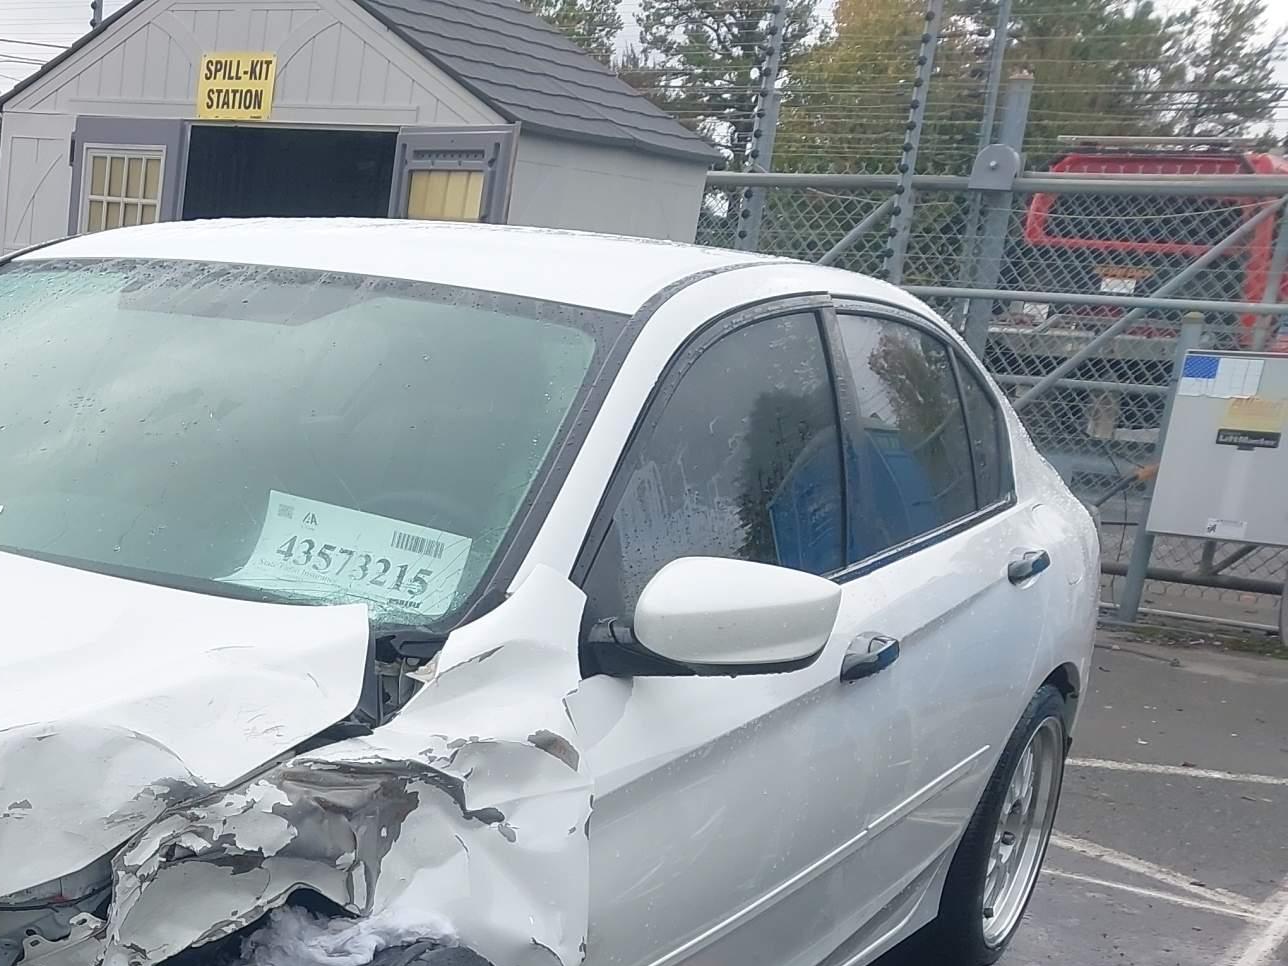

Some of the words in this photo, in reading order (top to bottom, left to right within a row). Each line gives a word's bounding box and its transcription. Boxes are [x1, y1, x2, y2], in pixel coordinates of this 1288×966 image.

[204, 59, 273, 81] SPILL-KIT
[206, 88, 264, 110] STATION
[276, 535, 433, 596] 43573215
